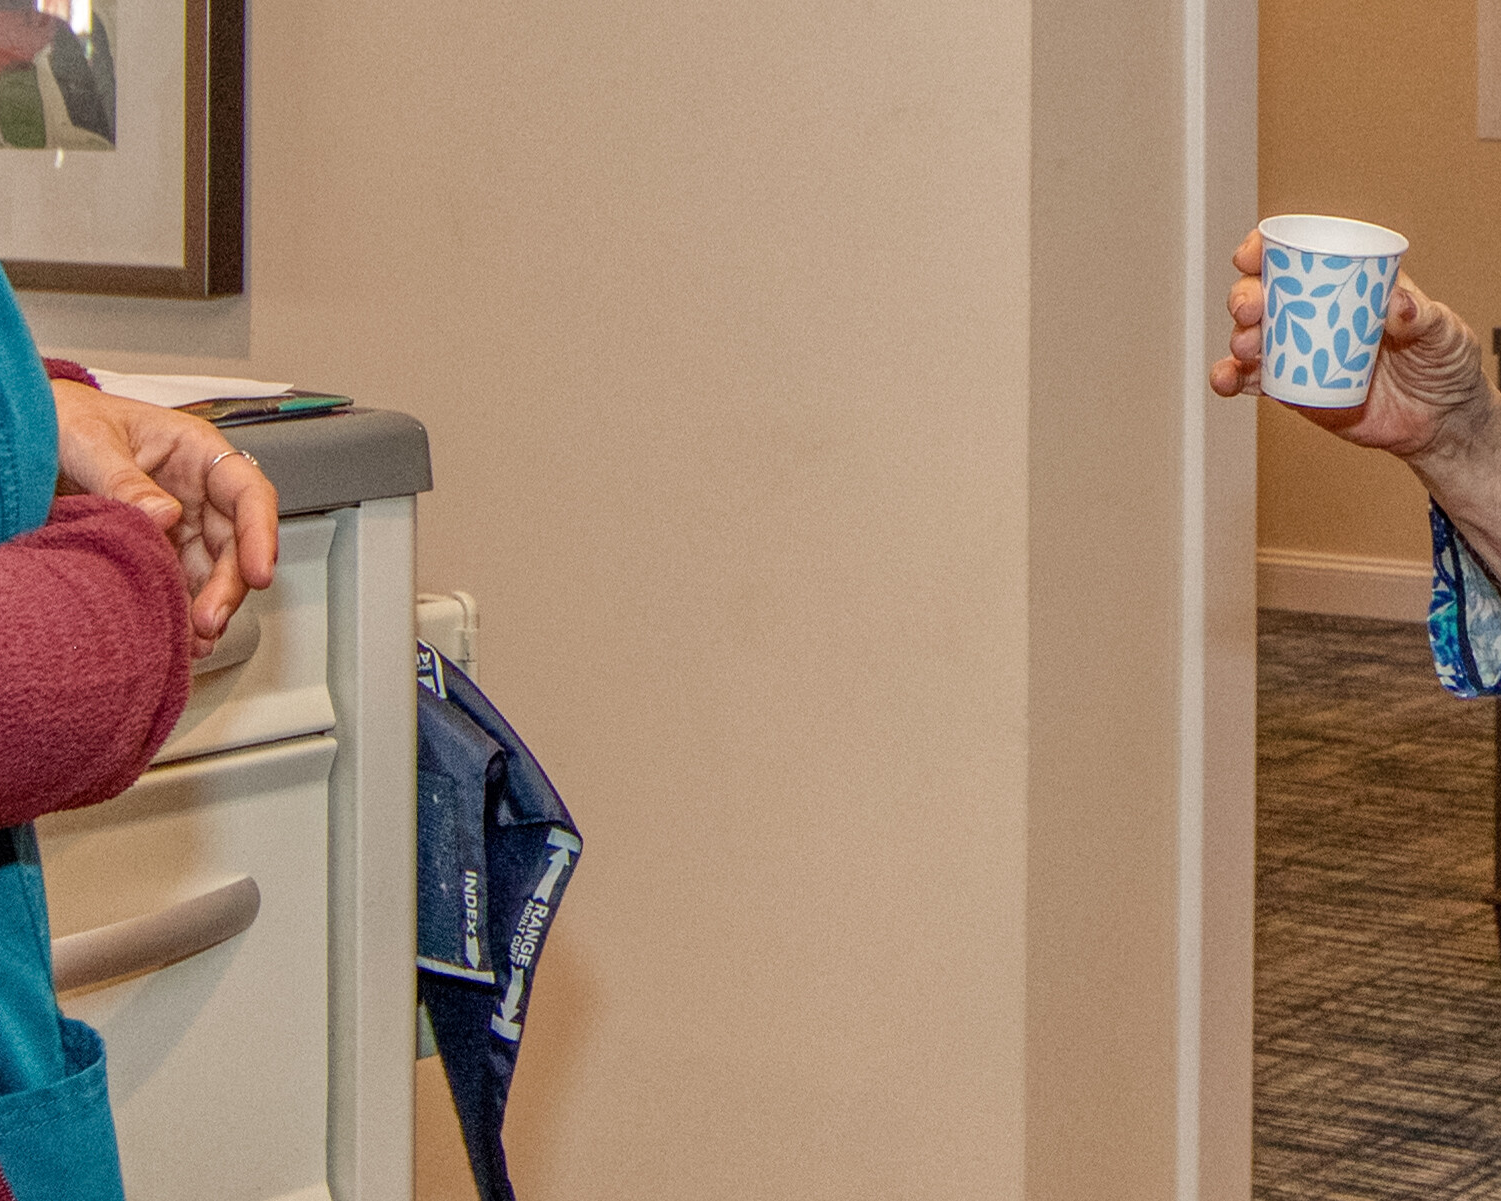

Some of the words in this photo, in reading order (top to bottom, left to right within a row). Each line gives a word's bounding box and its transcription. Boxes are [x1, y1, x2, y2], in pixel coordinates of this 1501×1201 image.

[464, 870, 478, 936] INDEX
[516, 899, 535, 934] ADULT
[516, 903, 549, 968] RANGE
